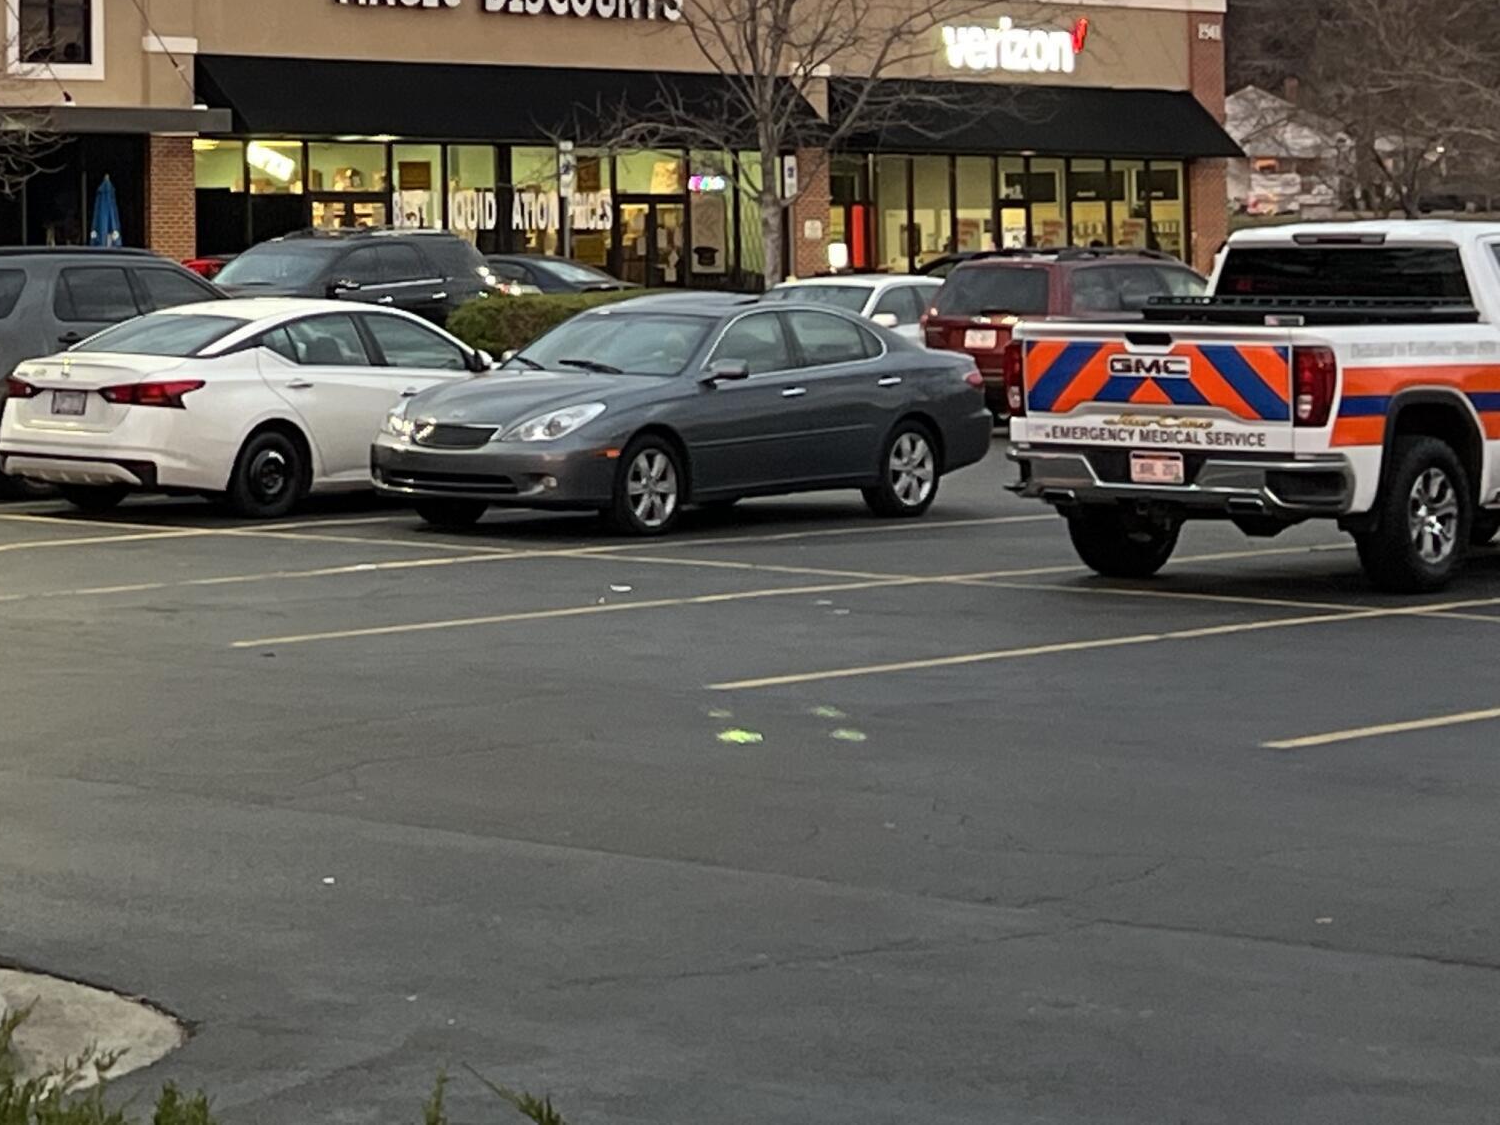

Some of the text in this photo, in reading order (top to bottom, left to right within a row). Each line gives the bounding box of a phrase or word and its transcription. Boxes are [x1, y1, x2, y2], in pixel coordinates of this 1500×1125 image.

[941, 16, 1075, 74] verizon
[1109, 357, 1190, 375] GMC
[1051, 425, 1135, 442] EMERGENCY
[1139, 428, 1202, 445] MEDICAL
[1205, 431, 1266, 447] SERVICE
